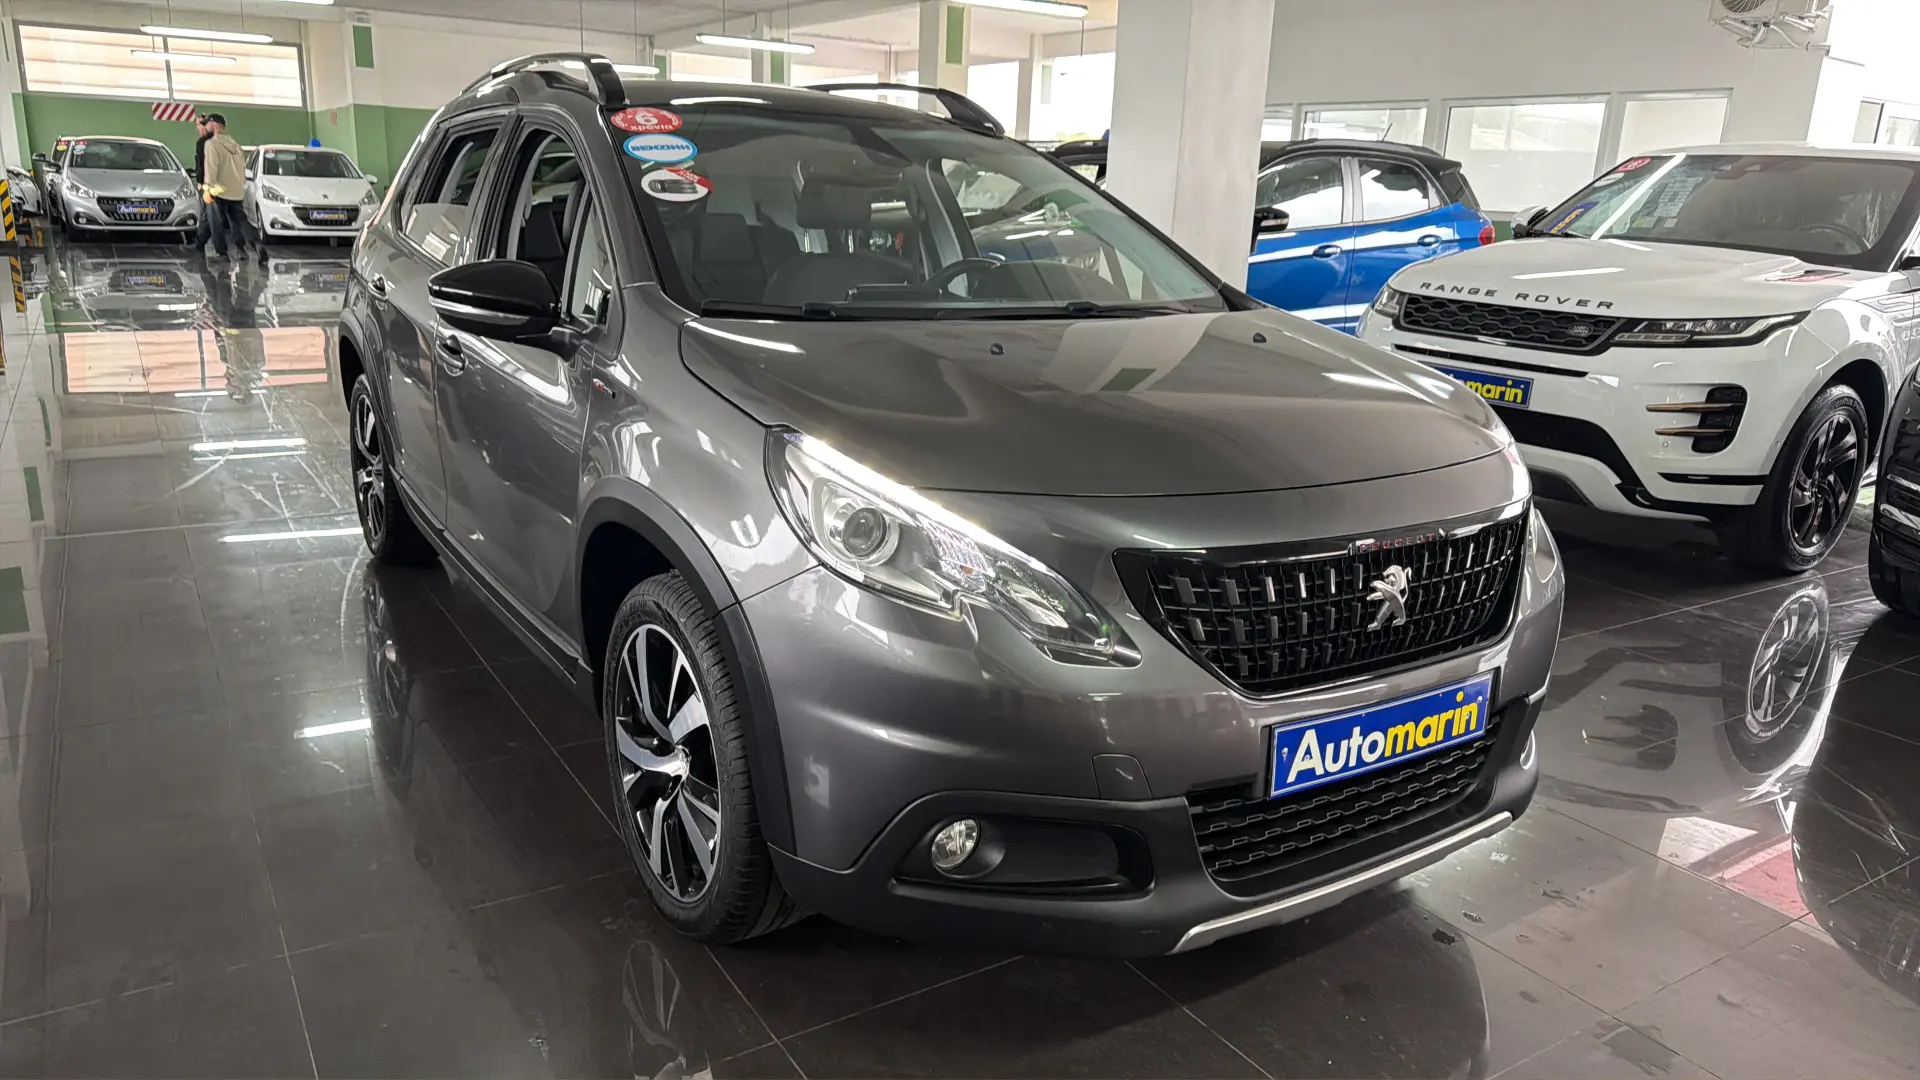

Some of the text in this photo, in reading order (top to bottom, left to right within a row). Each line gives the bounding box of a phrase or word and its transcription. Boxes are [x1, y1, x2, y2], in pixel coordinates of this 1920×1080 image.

[635, 111, 658, 126] 6
[1420, 282, 1614, 310] RANGE ROVER
[1450, 374, 1523, 403] marin
[1286, 691, 1479, 784] Automarin
